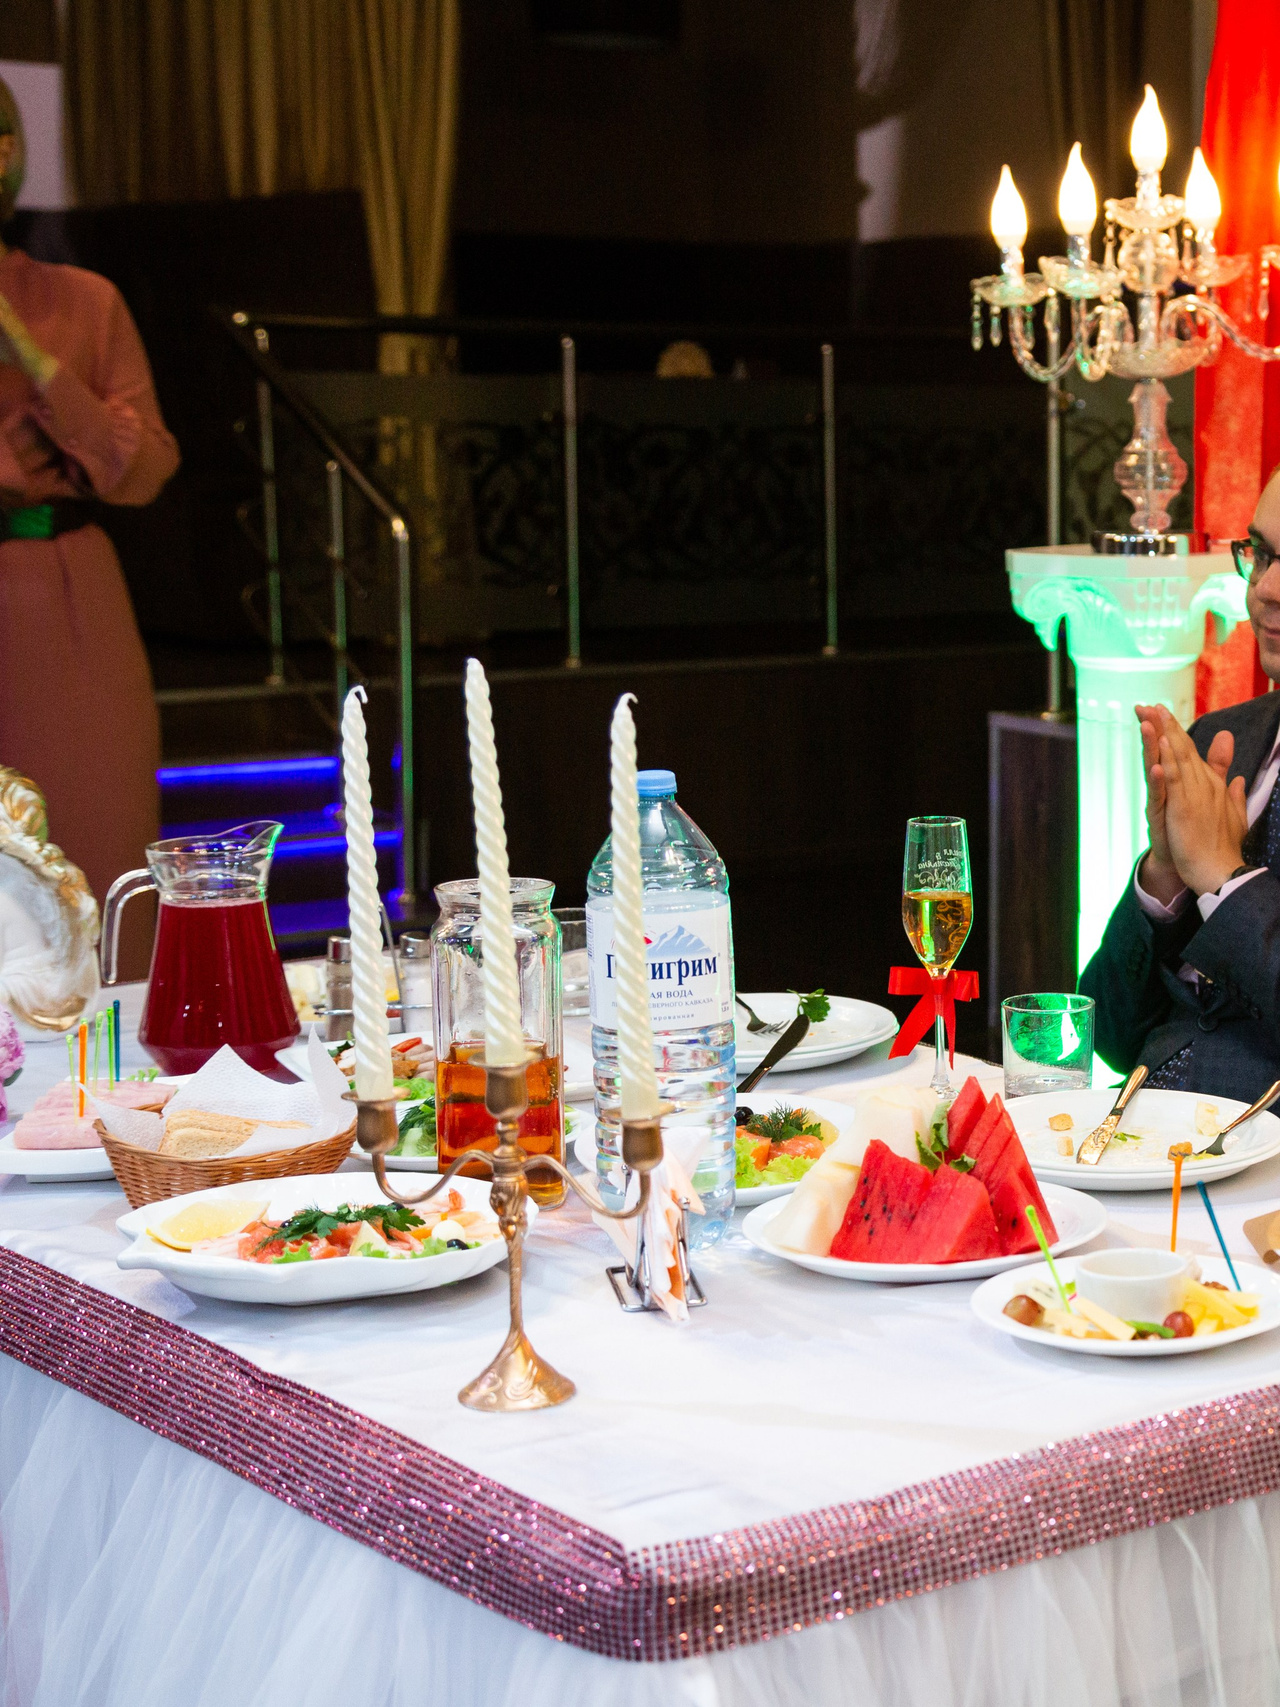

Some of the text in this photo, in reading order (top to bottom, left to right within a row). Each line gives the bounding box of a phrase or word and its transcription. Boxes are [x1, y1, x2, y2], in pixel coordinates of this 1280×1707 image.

[605, 953, 717, 985] Пигрим
[666, 989, 694, 999] ВОДА
[648, 1001, 684, 1009] ЕВЕРНОГО
[685, 997, 714, 1006] КАВКАЗА
